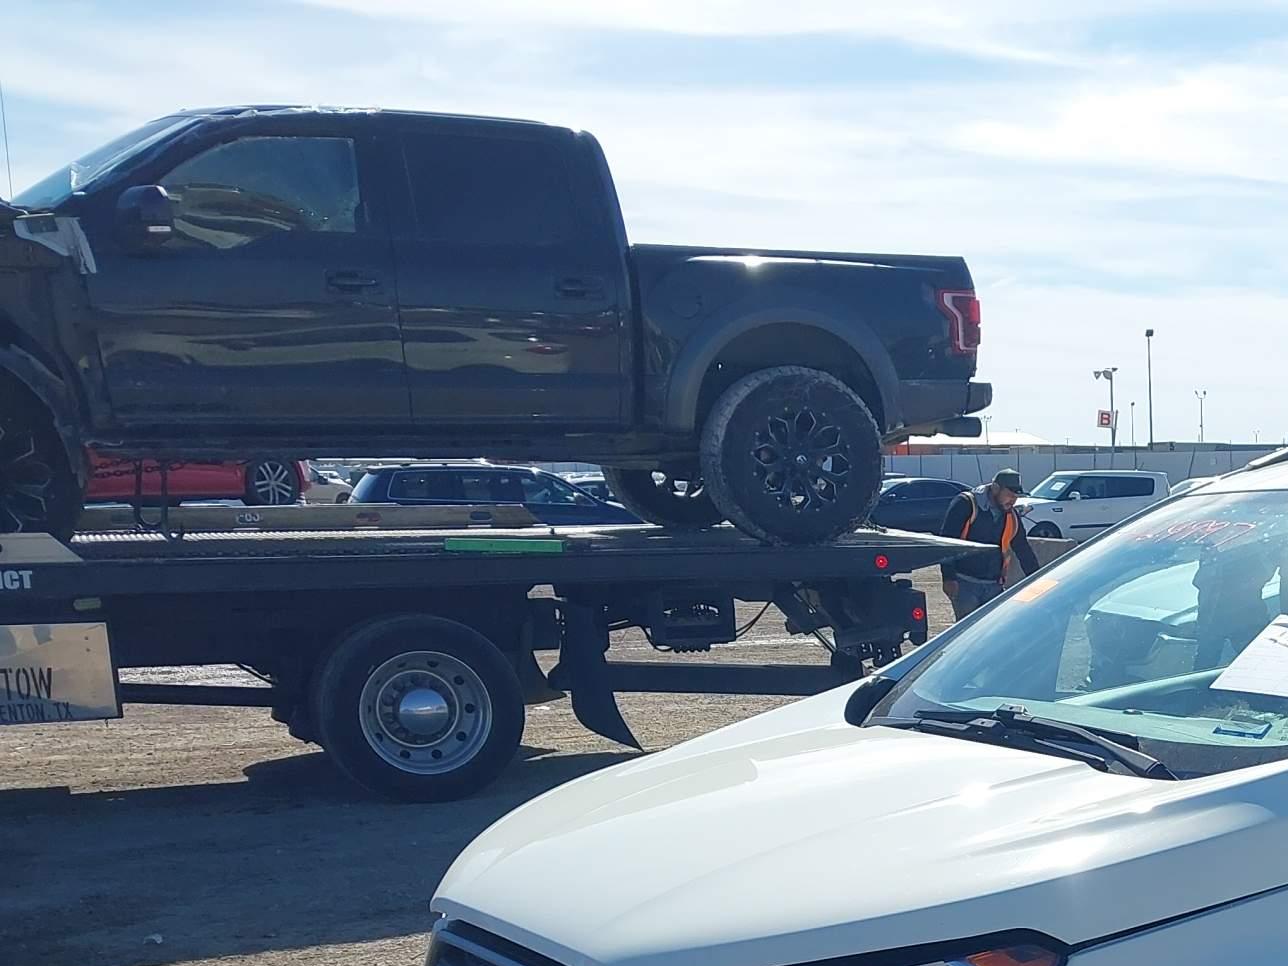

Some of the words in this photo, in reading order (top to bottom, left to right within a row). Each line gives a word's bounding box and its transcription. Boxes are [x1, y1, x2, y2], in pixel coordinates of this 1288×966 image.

[1100, 412, 1111, 426] B
[0, 667, 52, 700] TOW
[53, 702, 73, 720] TX
